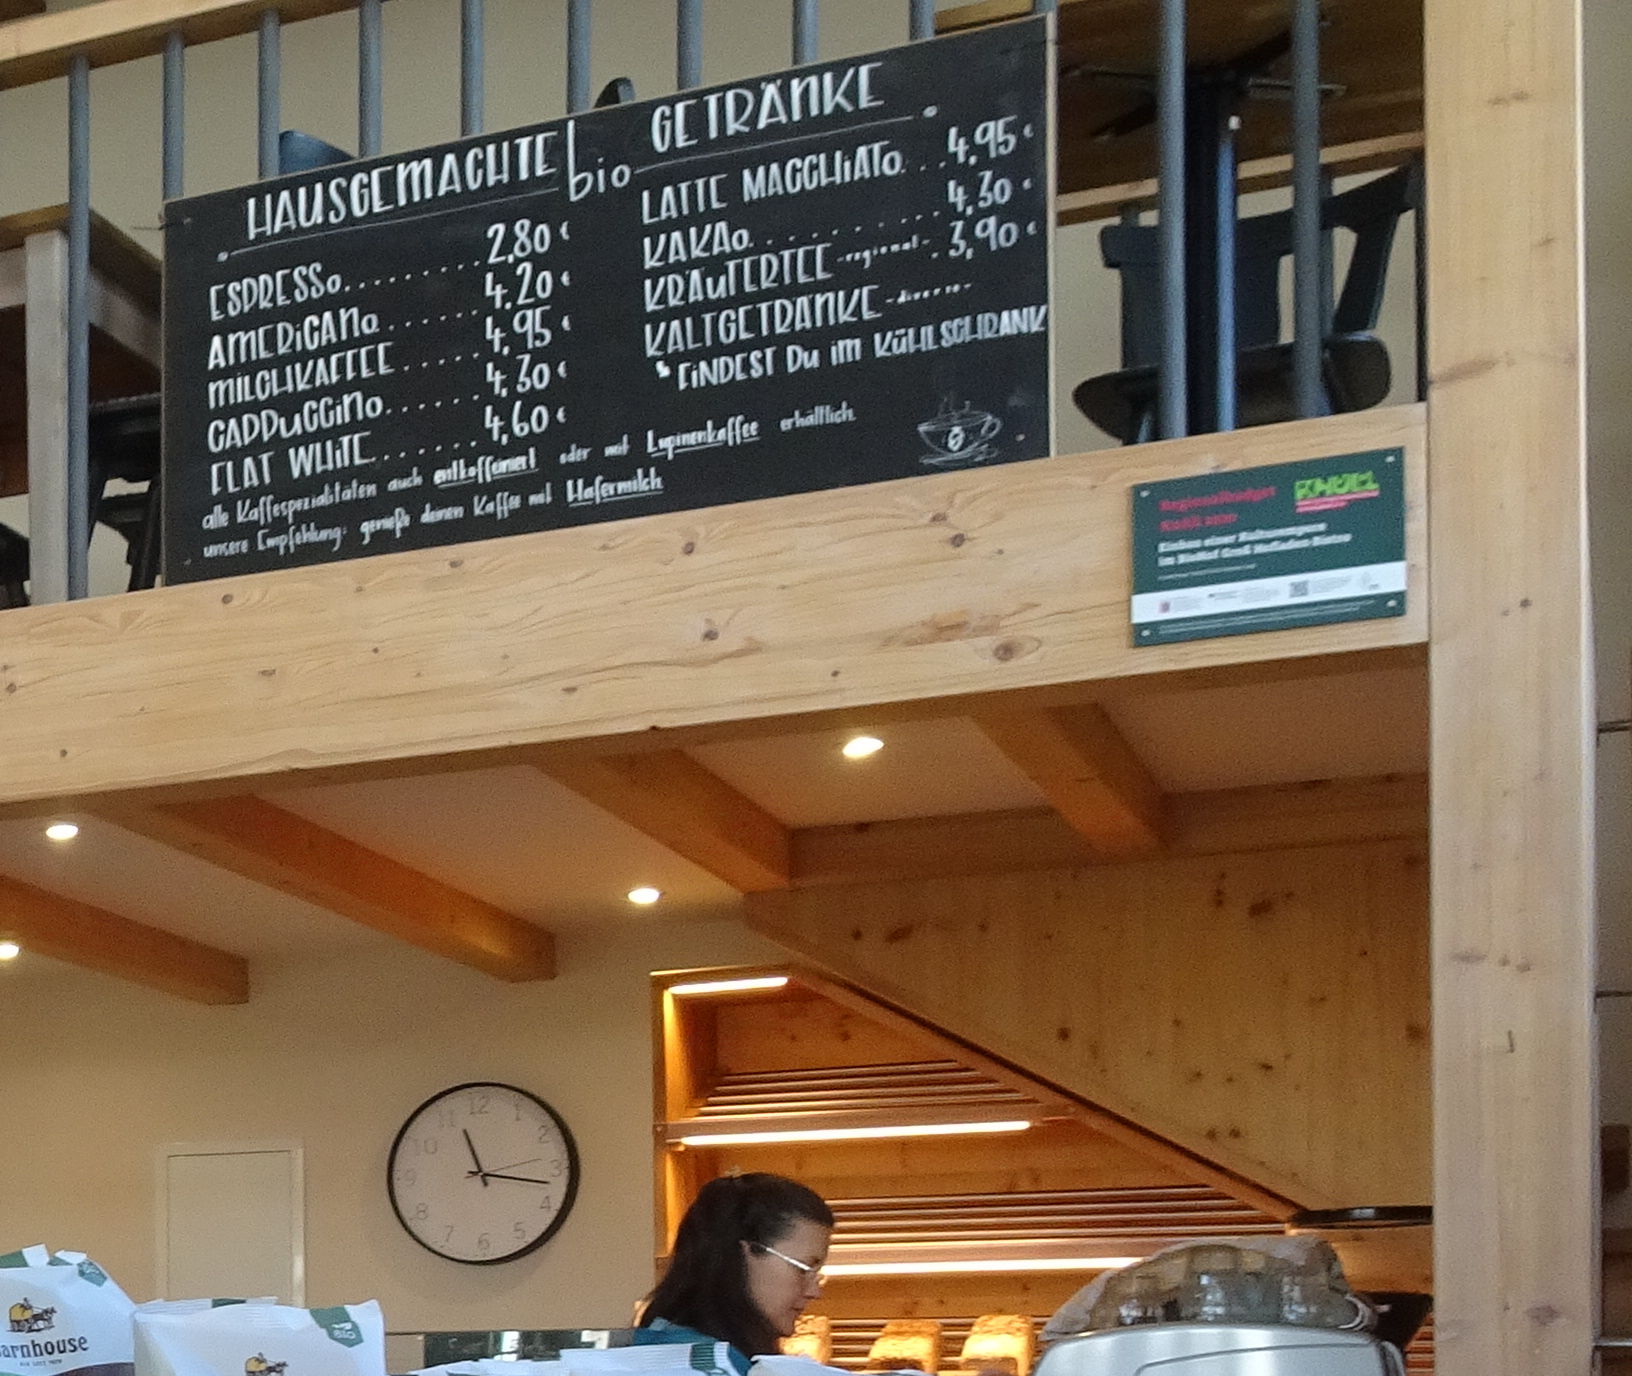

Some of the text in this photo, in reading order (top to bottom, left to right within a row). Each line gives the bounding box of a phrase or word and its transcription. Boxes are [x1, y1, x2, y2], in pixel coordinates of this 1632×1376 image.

[247, 62, 885, 240] HAUSGEMACHTE bio GETRÄNKE
[642, 115, 1017, 225] LATTE MACCHIATO 4,95
[486, 218, 551, 265] 2,80
[643, 169, 1012, 270] KAKAO 4,30
[644, 214, 1019, 313] KRÄUTERTEE 3,90
[208, 304, 552, 410] MILCHKAFFEE 4,95
[644, 284, 882, 359] KALTGETRÄNKE
[678, 347, 777, 391] FINDEST
[874, 304, 1047, 358] KÜHLSCHRANK
[208, 353, 551, 453] CAPPUCCINO 4,30
[202, 504, 229, 531] alle
[388, 466, 423, 493] auch
[646, 415, 760, 460] Lupinenkaffee
[210, 400, 549, 498] FLAT WHITE 4,60
[203, 535, 248, 559] unsere
[567, 467, 664, 505] Hafermilch
[469, 1097, 490, 1115] 12
[538, 1124, 550, 1144] 2
[540, 1195, 552, 1213] 4
[550, 1158, 563, 1178] 3
[444, 1224, 454, 1243] 7
[477, 1232, 491, 1251] 6
